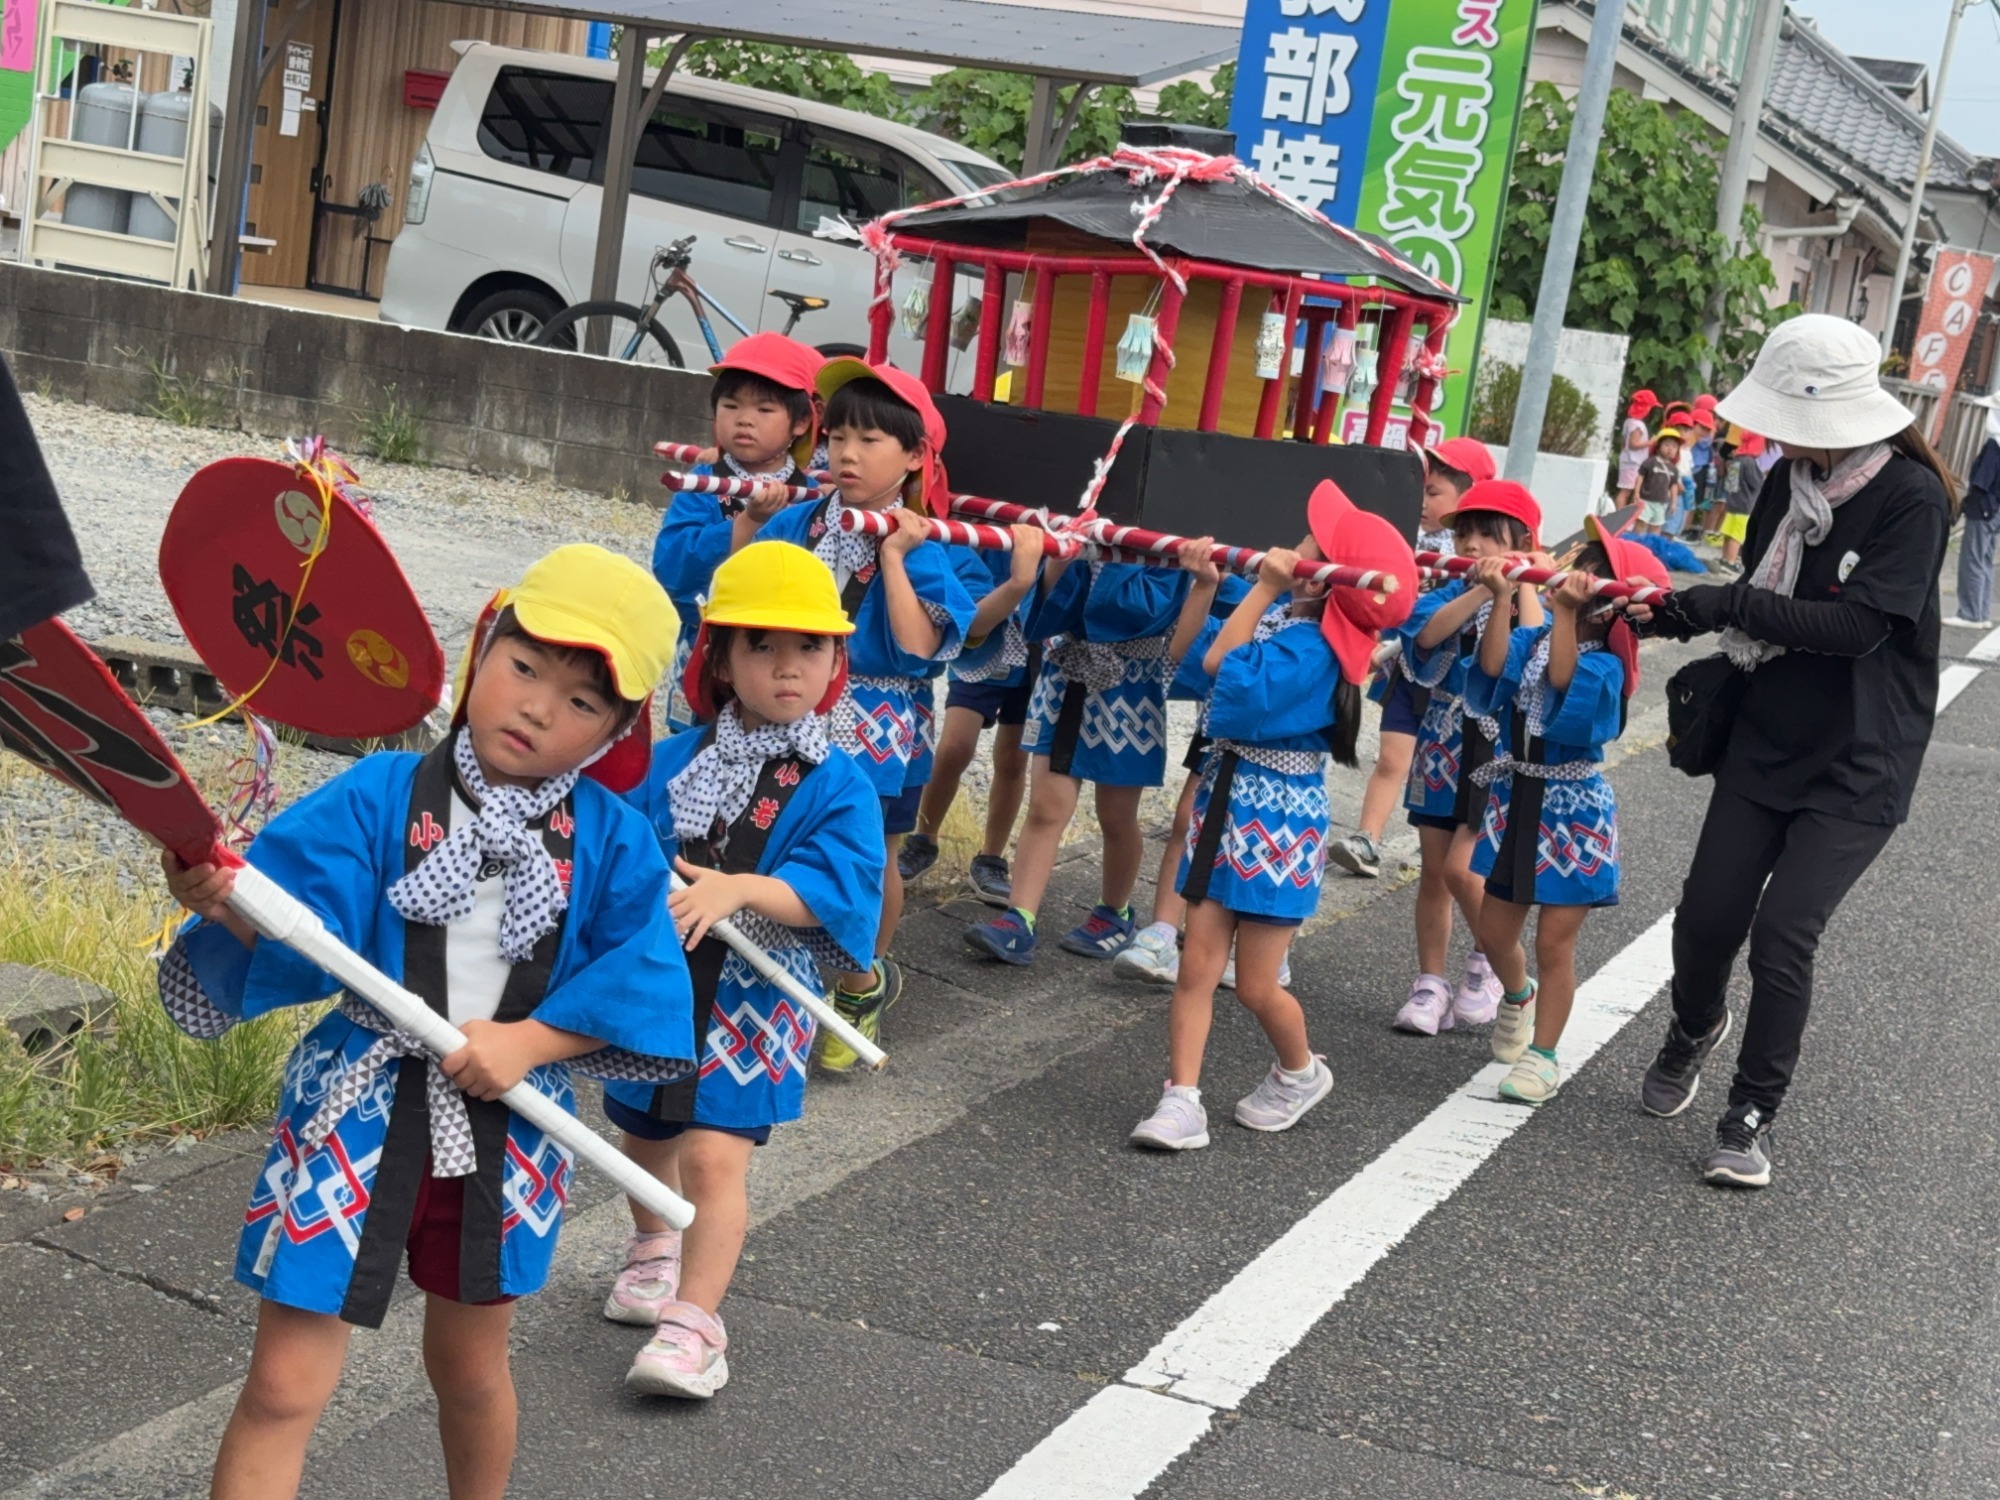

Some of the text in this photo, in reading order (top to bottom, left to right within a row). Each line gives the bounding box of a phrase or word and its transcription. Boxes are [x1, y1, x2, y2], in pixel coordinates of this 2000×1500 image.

[1451, 0, 1504, 48] ス
[1251, 0, 1366, 210] 部接
[232, 562, 325, 681] 祭
[750, 761, 801, 831] 小若
[409, 811, 445, 852] 小
